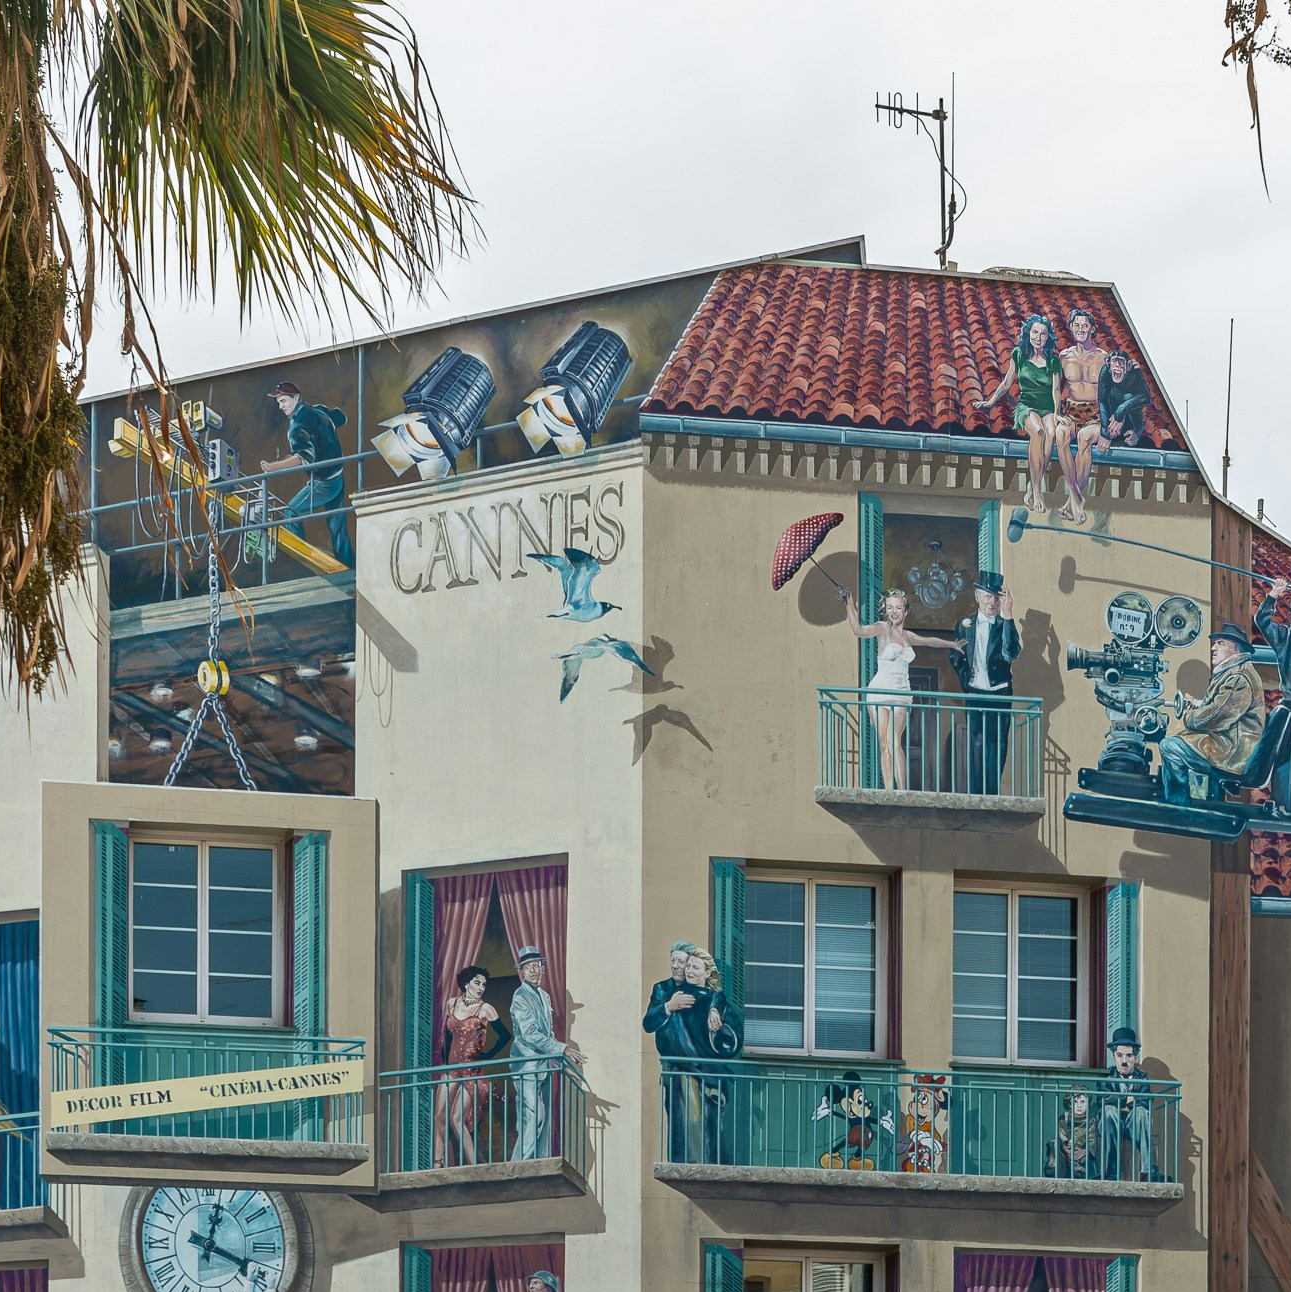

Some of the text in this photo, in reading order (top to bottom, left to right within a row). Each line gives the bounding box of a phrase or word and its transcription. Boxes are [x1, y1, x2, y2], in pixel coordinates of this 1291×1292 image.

[390, 480, 626, 595] CANNES
[1117, 612, 1142, 624] BOBINE
[66, 1097, 123, 1113] DÉCOR
[129, 1090, 172, 1106] FILM
